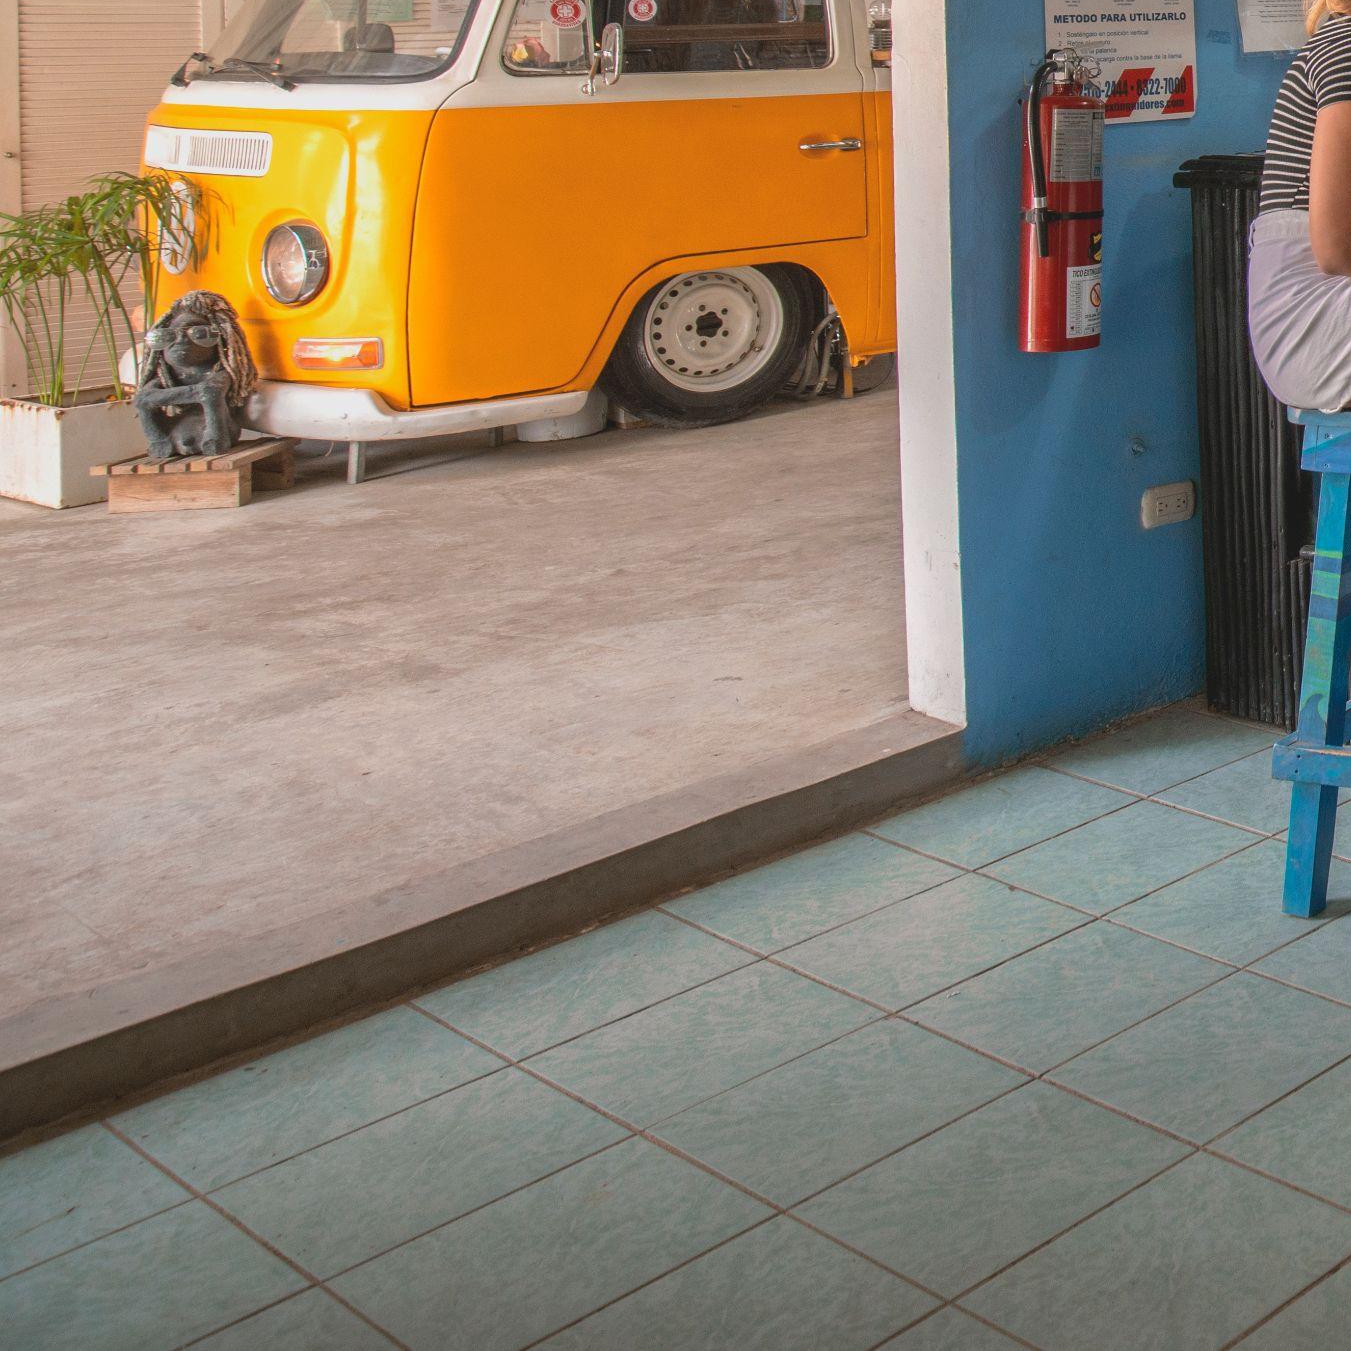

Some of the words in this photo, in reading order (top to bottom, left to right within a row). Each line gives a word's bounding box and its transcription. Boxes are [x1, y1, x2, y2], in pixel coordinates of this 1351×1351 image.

[1053, 14, 1098, 24] METODO
[1101, 13, 1127, 22] PARA
[1129, 12, 1186, 22] UTILIZARLO
